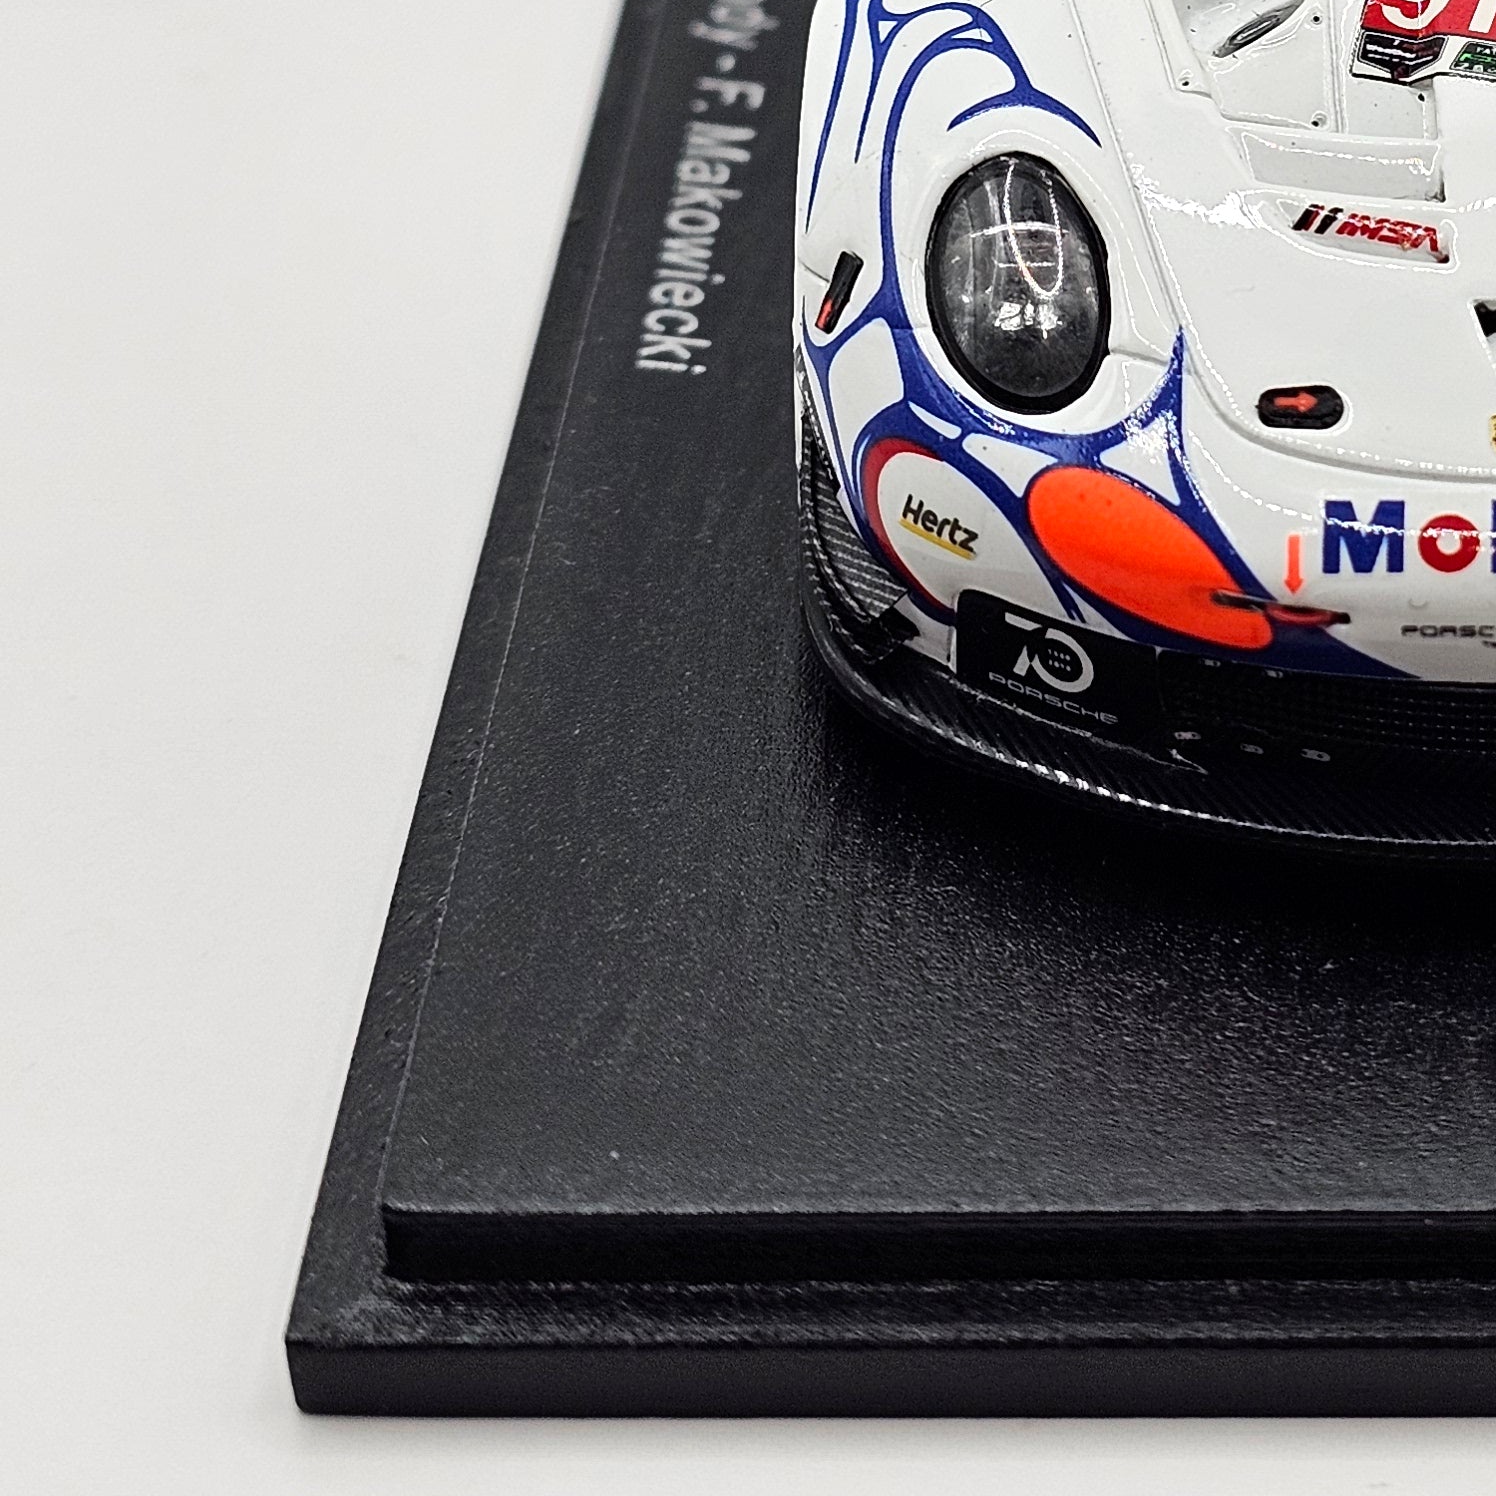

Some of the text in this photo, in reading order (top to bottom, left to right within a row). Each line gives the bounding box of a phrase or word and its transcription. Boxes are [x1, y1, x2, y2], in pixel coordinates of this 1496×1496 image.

[635, 121, 756, 375] Makowiecki
[901, 493, 979, 555] Hertz
[988, 671, 1119, 725] PORSCHE
